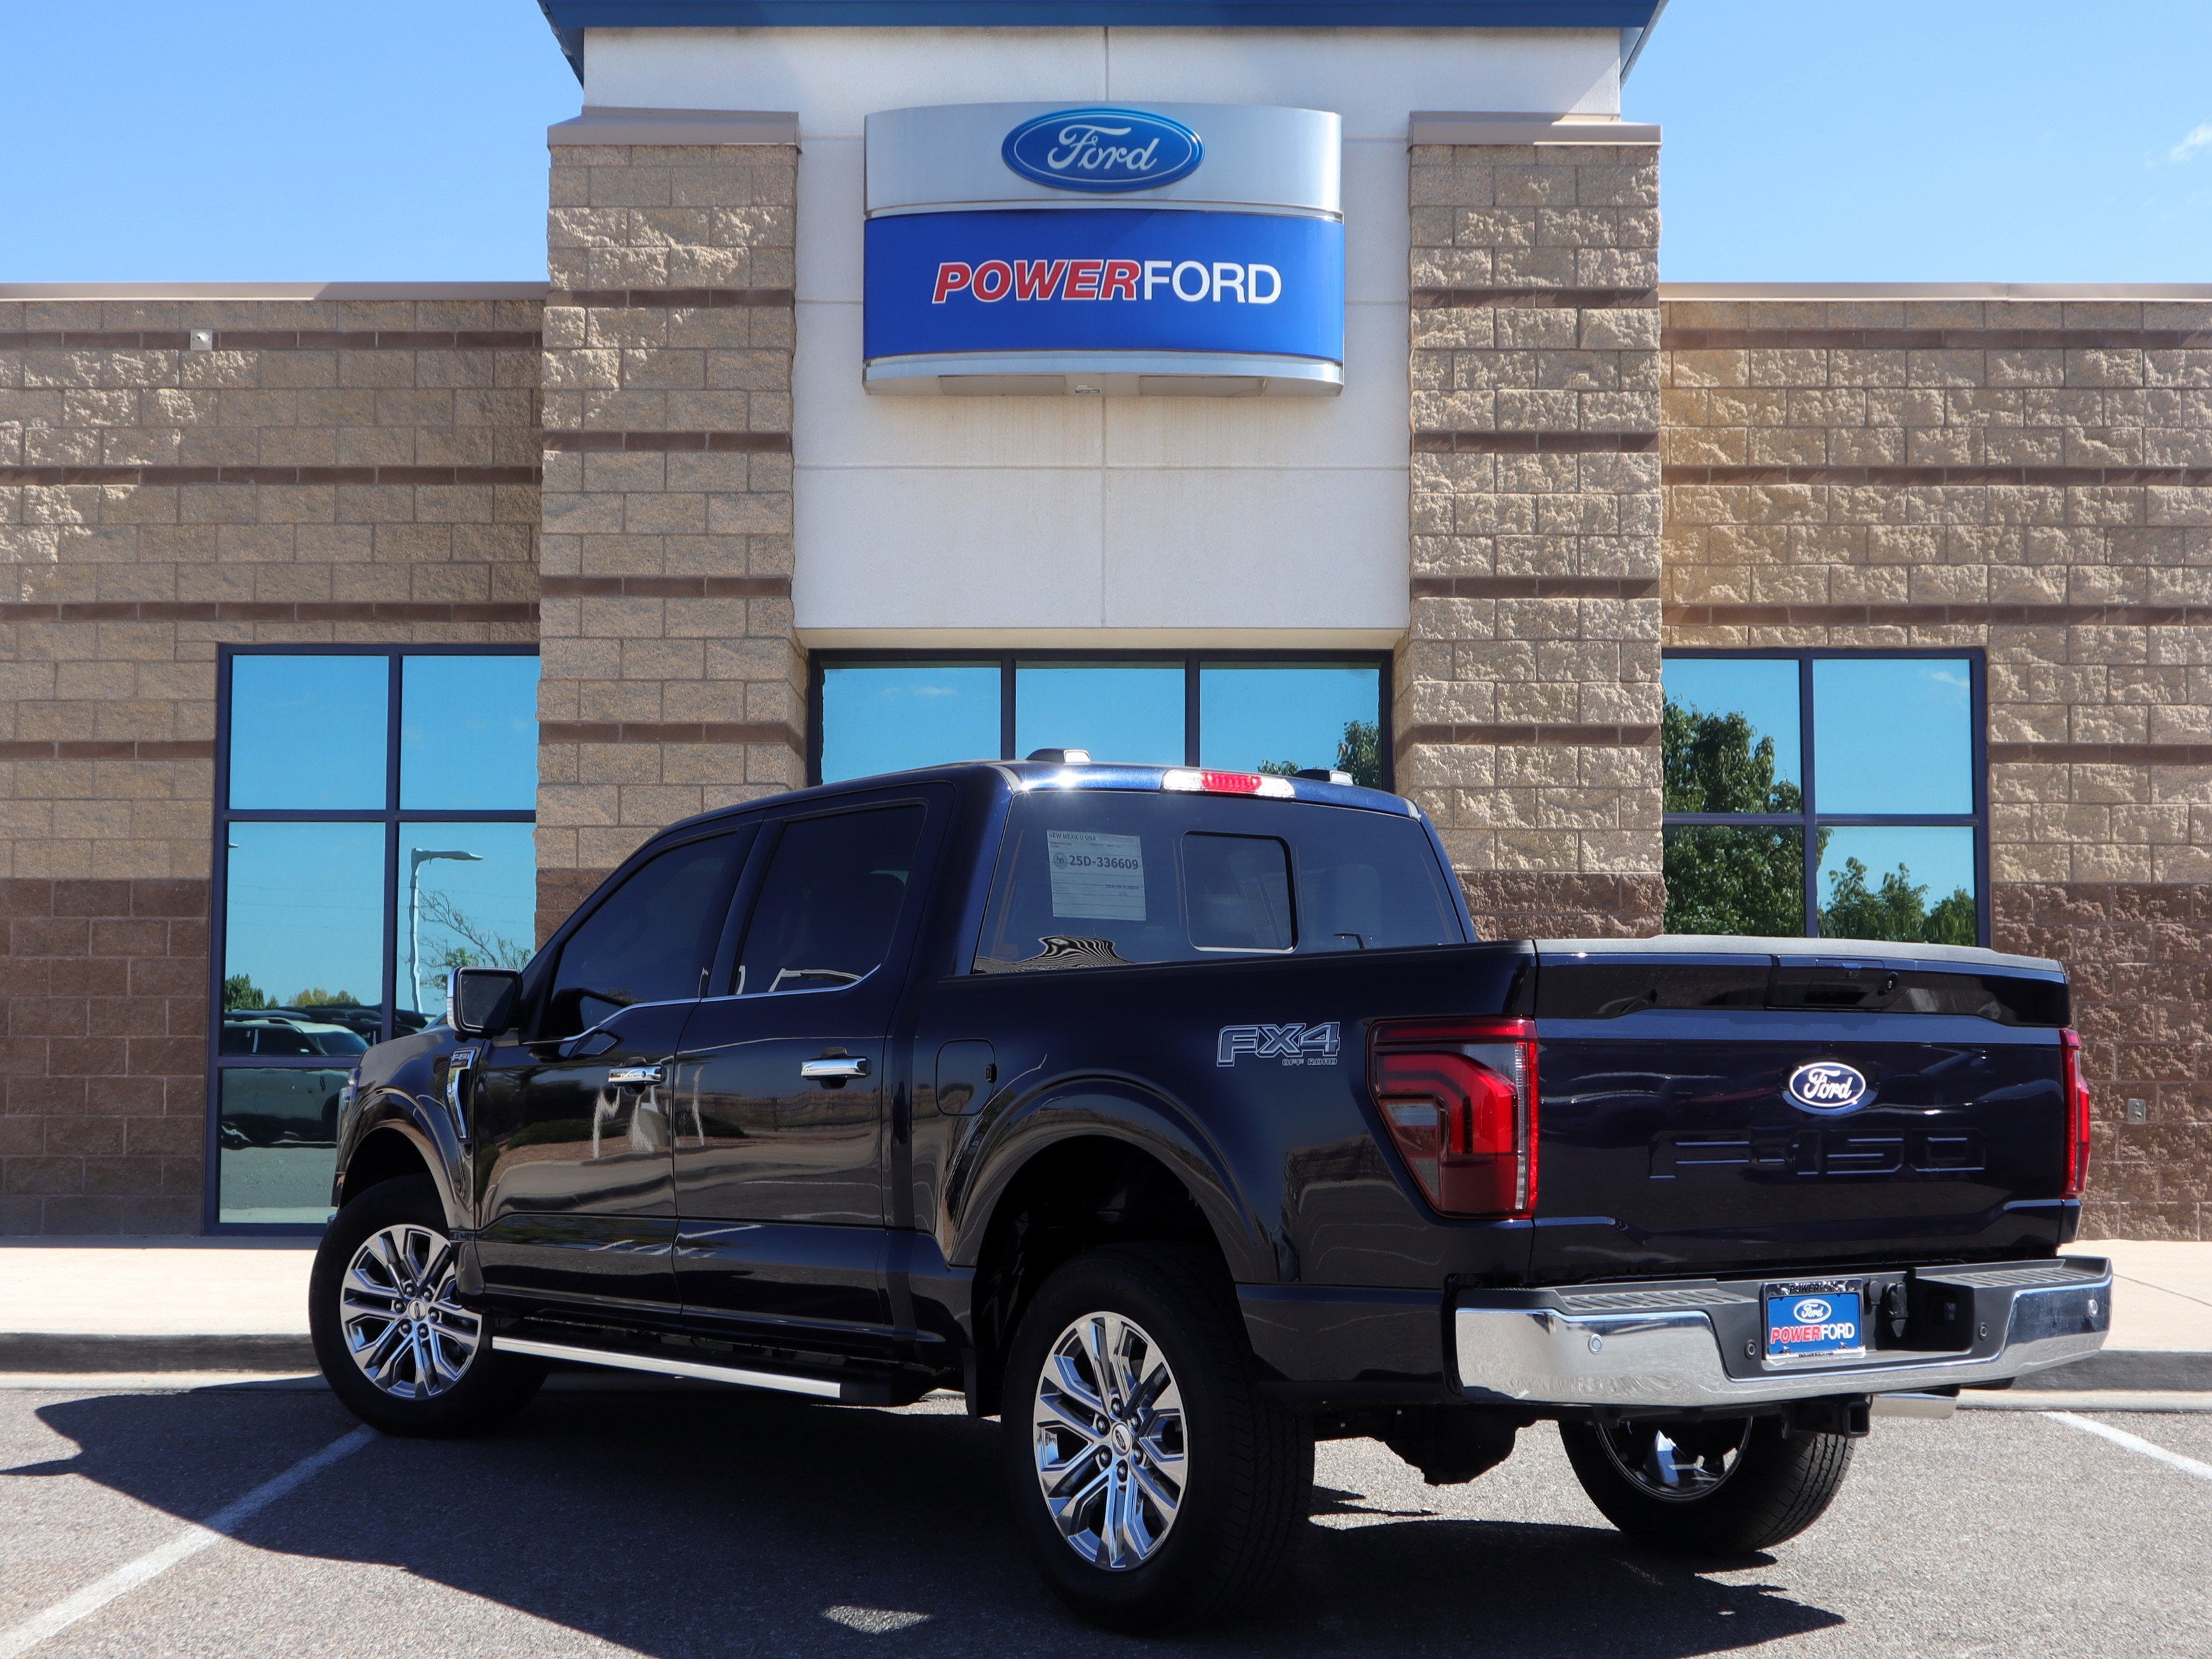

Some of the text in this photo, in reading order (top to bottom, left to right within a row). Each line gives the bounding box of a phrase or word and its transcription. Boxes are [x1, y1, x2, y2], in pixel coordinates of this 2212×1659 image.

[1048, 124, 1159, 171] Ford
[931, 259, 1282, 304] POWERFORD
[1069, 855, 1139, 870] 25D-336609
[1216, 1022, 1341, 1066] FX4
[1307, 1057, 1337, 1066] ROAD
[1803, 1068, 1853, 1099] Ford
[1801, 1304, 1824, 1318] Ford
[1770, 1322, 1855, 1345] POWERFORD
